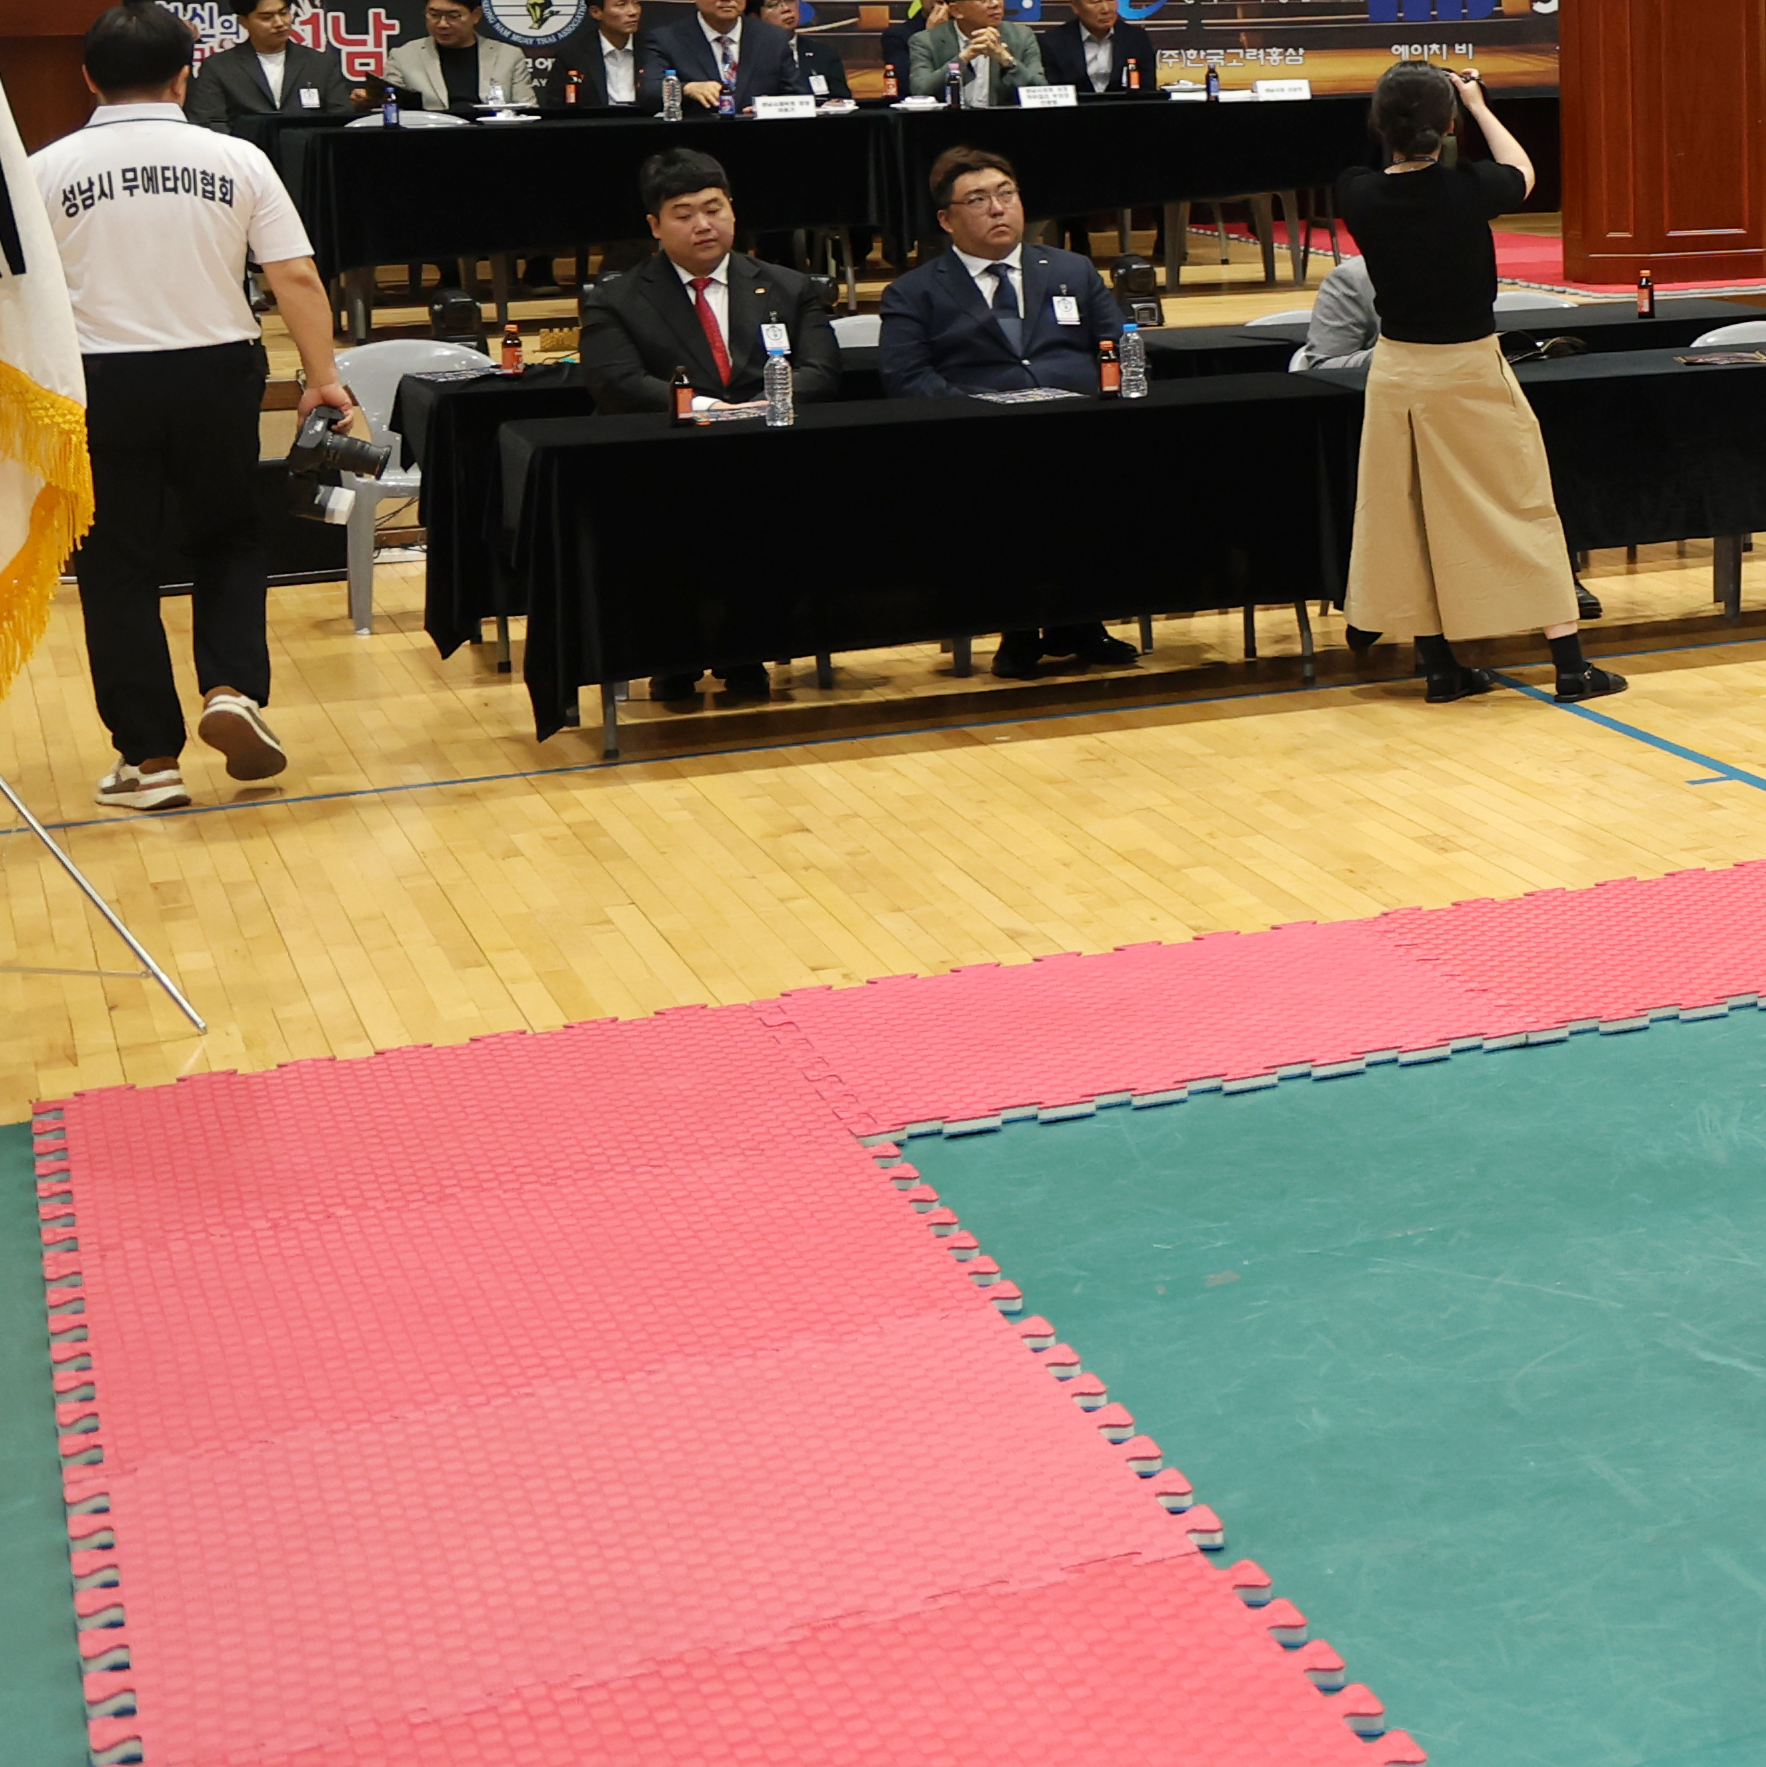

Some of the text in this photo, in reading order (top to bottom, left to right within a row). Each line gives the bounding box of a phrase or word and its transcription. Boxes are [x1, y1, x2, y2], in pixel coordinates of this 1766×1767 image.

[1156, 48, 1304, 68] (주)한국고려홍삼
[1391, 43, 1474, 61] 에이치 비
[61, 164, 235, 218] 성남시 무에타이협회
